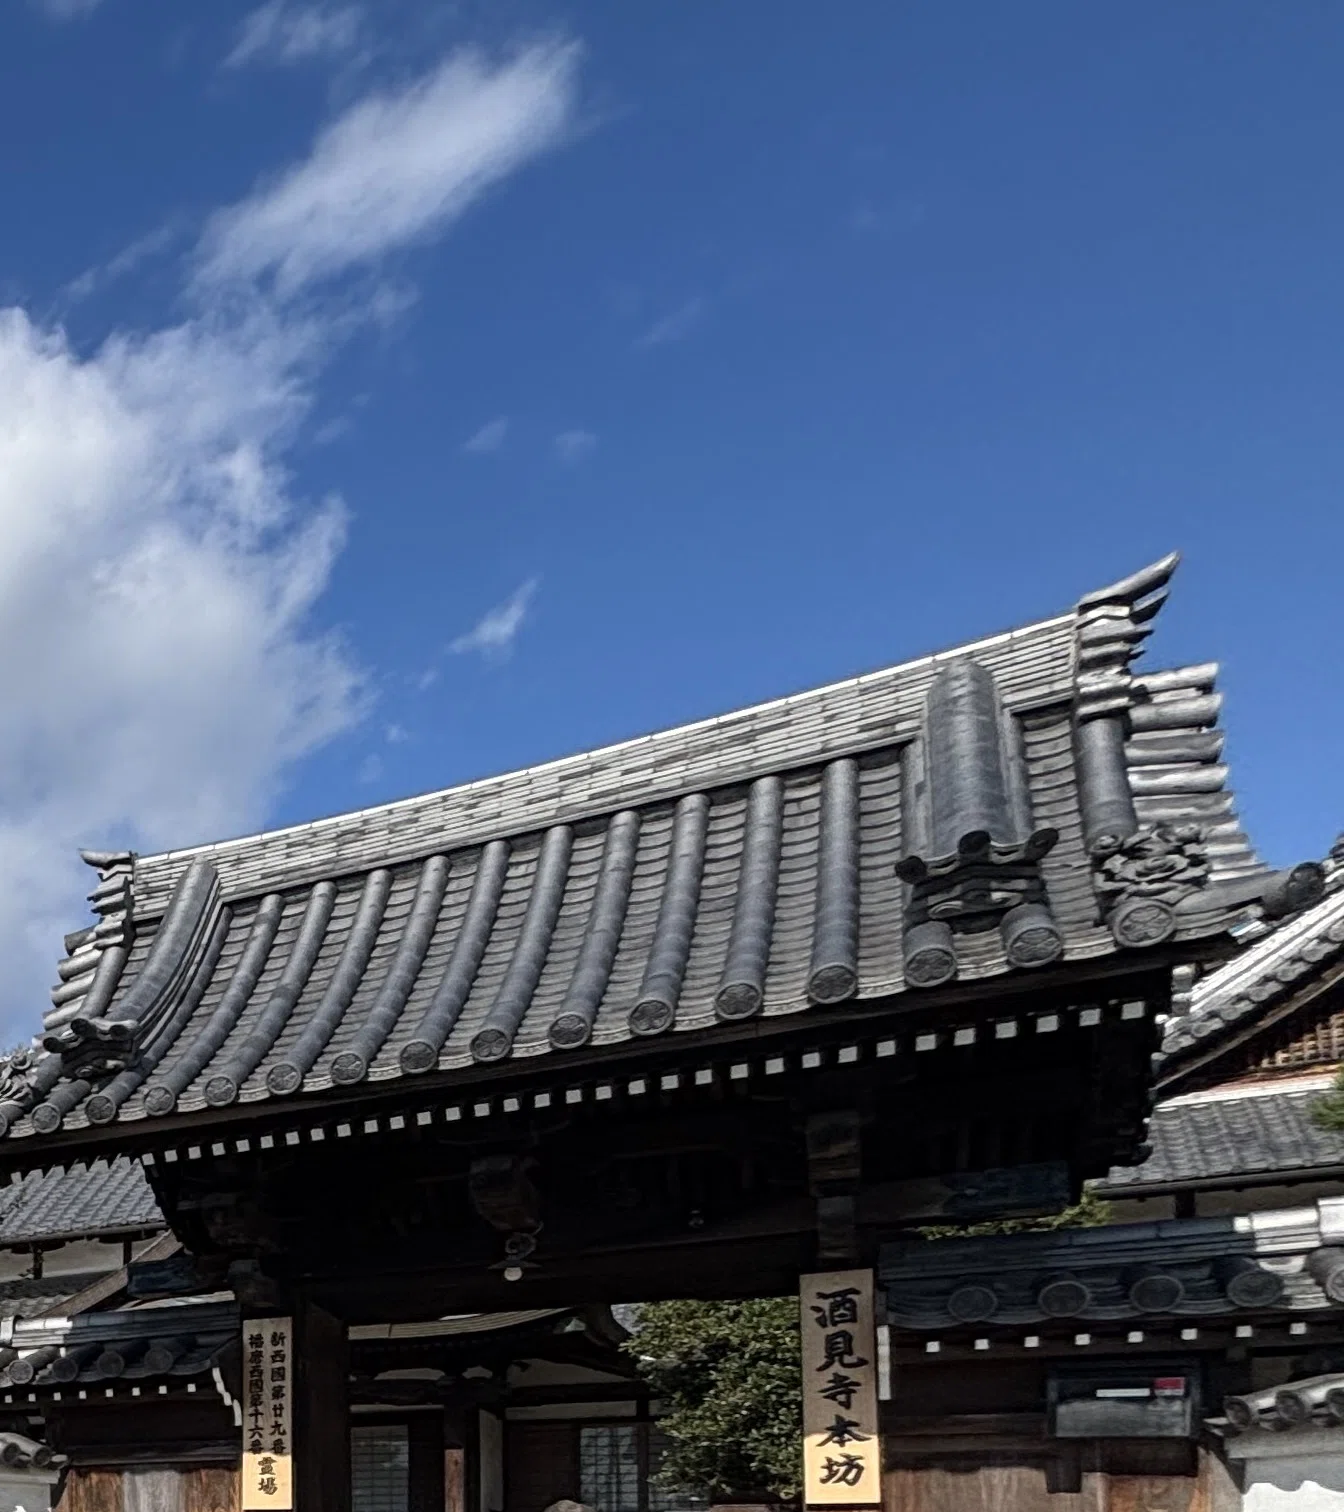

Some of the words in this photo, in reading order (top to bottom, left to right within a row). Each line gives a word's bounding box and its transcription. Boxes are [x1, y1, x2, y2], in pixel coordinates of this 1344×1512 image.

[811, 1287, 872, 1487] 酒見寺本坊
